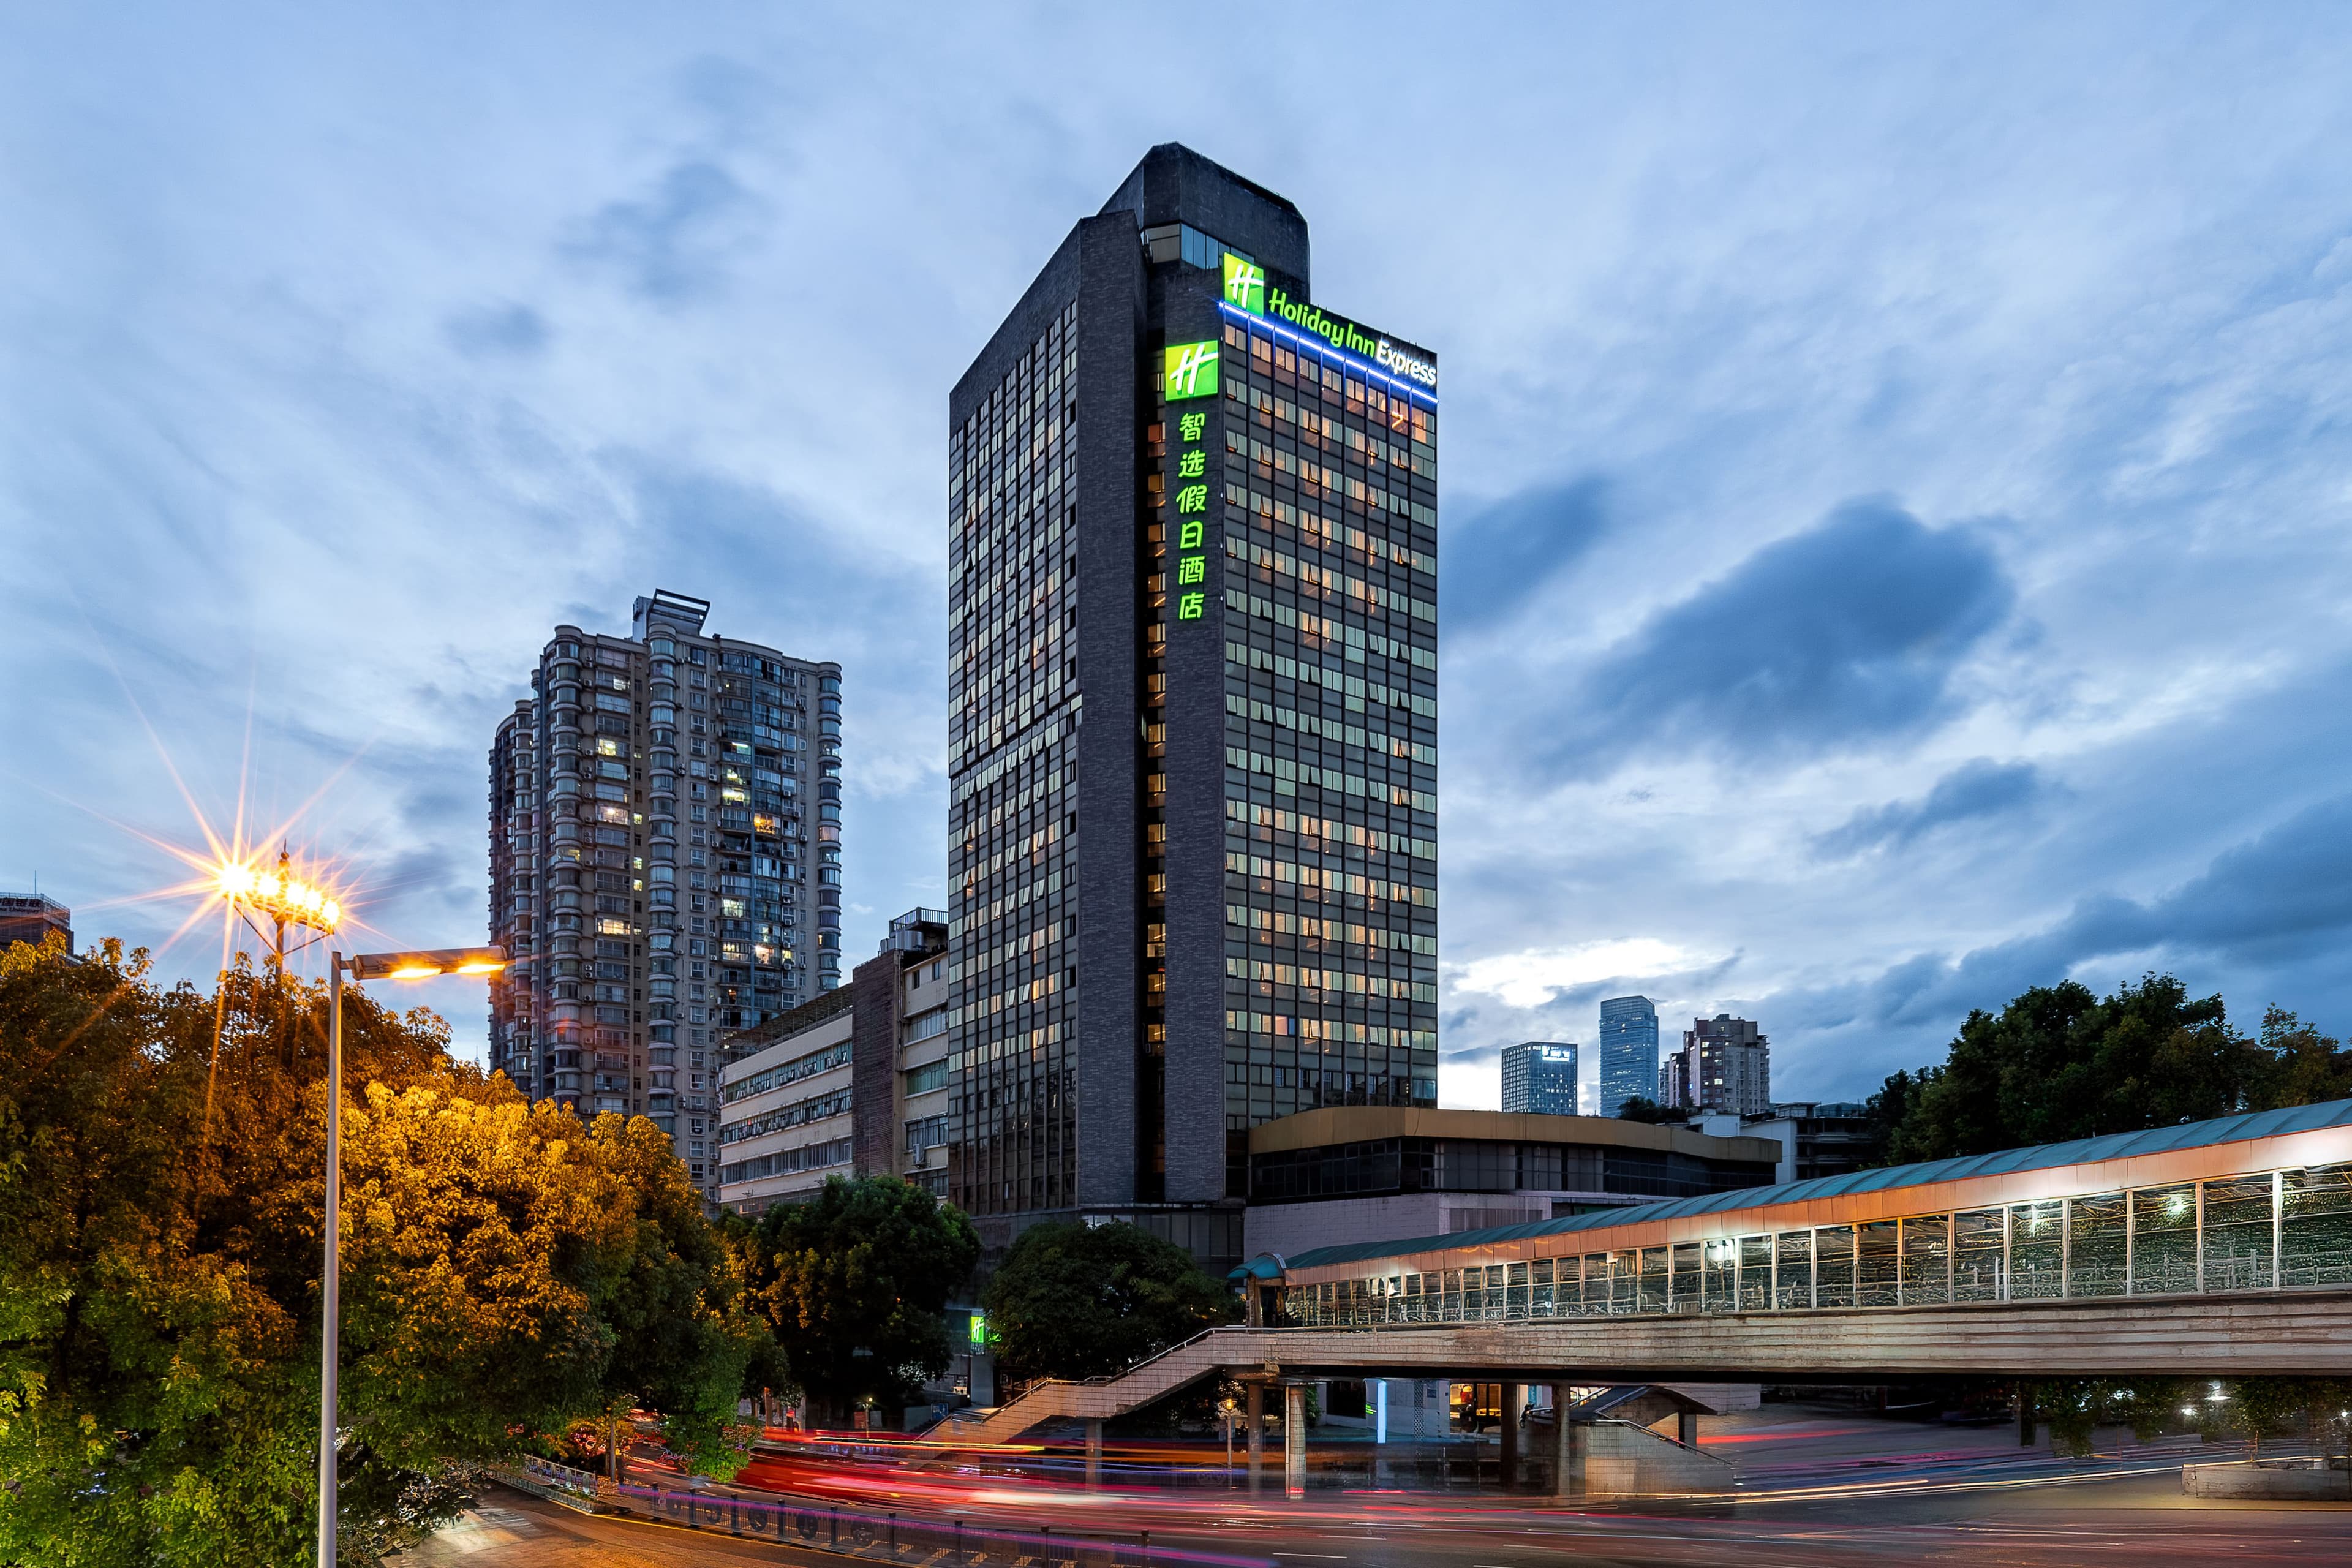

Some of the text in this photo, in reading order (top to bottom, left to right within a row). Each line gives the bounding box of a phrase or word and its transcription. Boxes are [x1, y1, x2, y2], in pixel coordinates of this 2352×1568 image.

[1268, 287, 1437, 386] Holiday Inn Express
[1175, 412, 1207, 620] 智选假日酒店
[0, 898, 40, 907] 国银联
